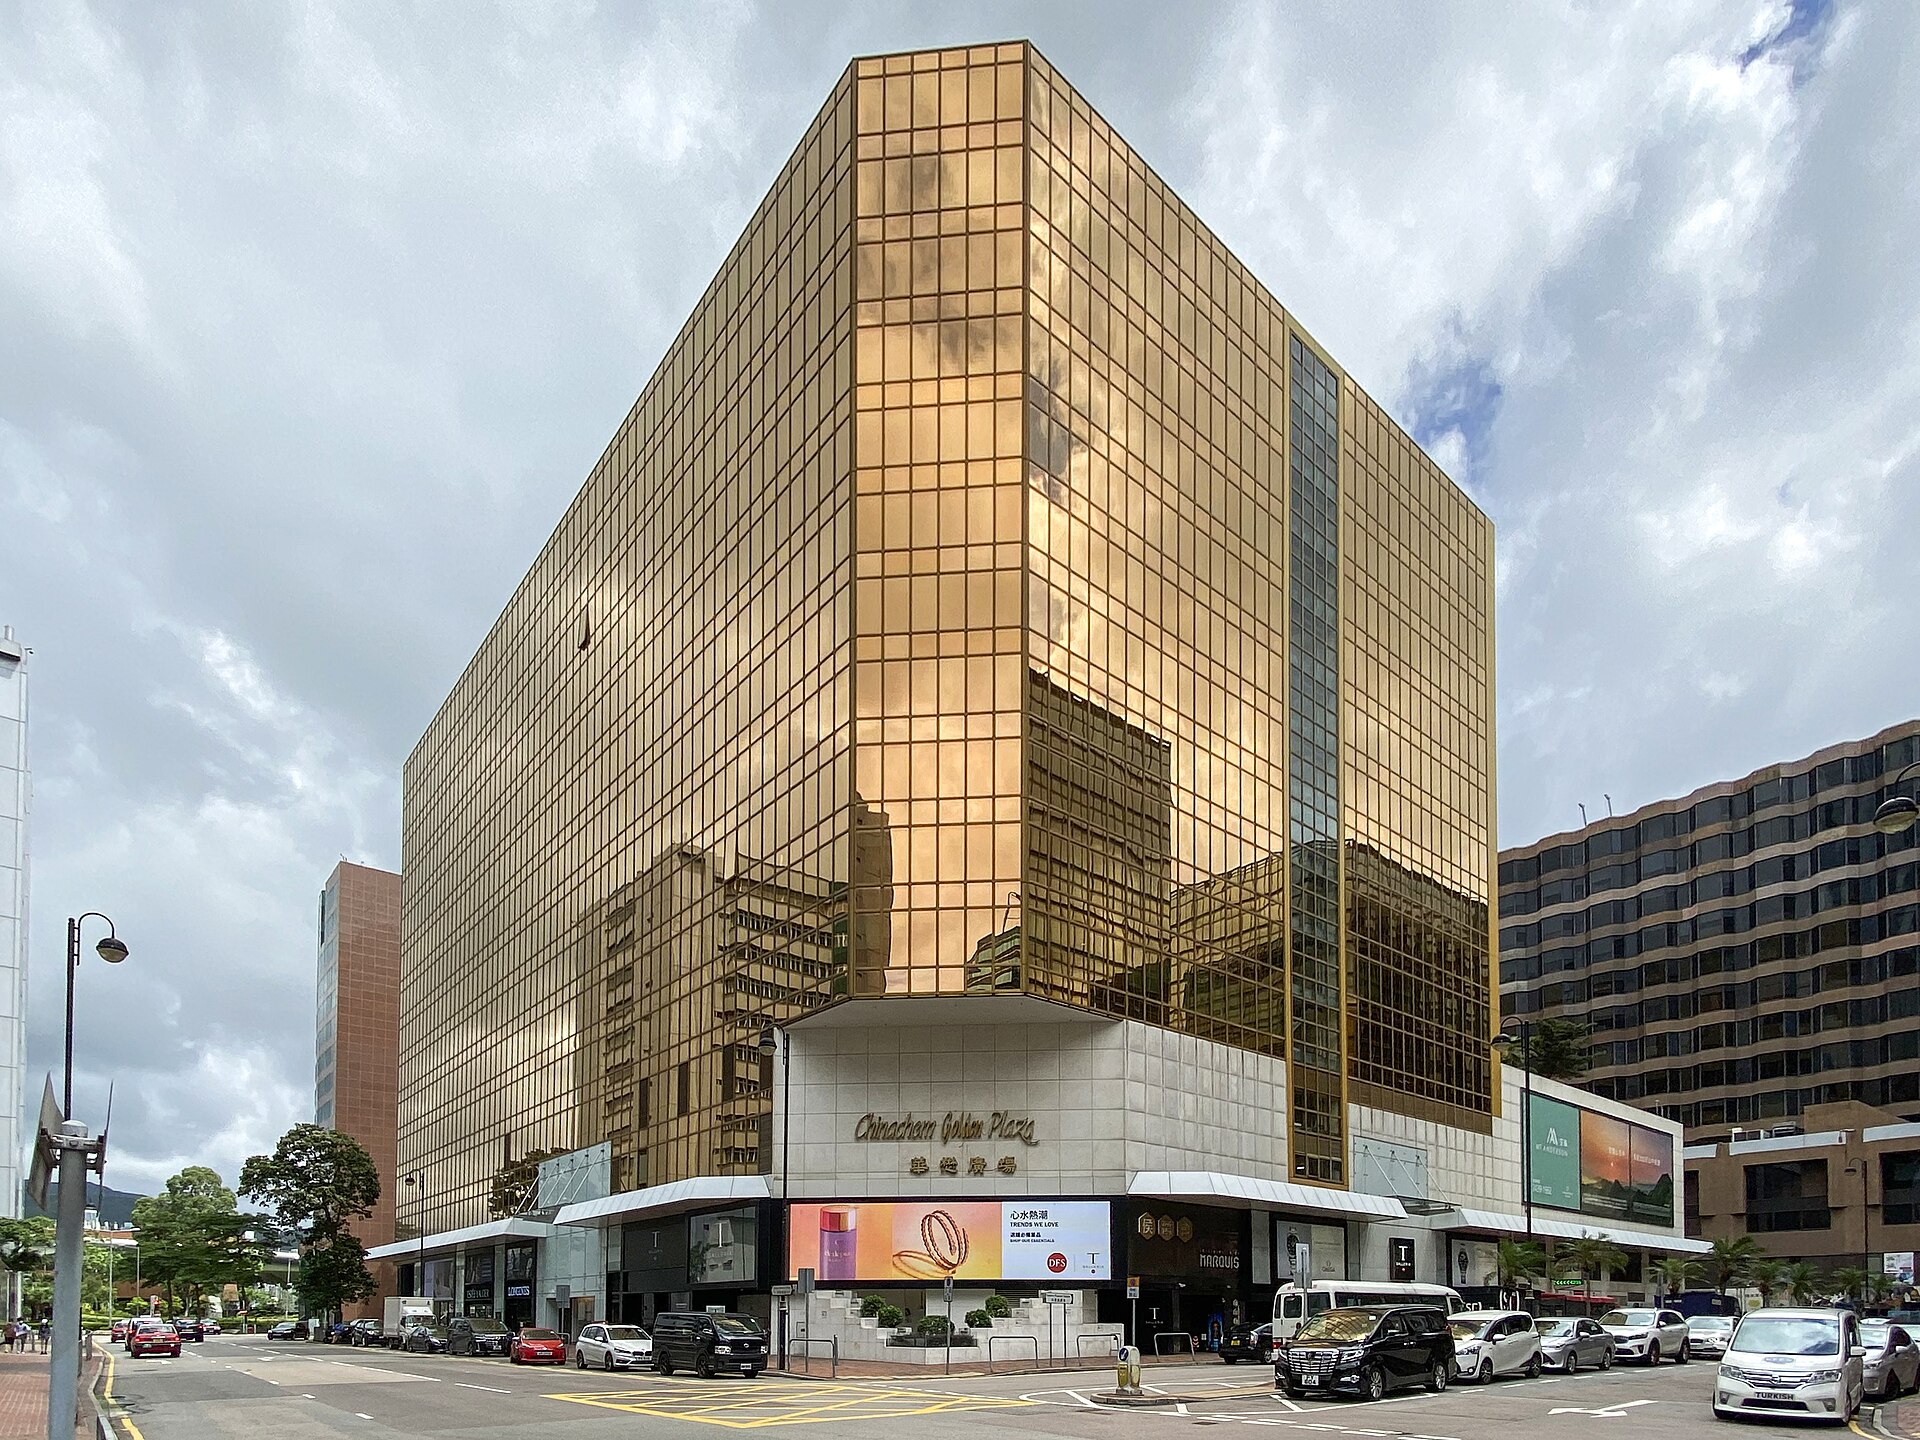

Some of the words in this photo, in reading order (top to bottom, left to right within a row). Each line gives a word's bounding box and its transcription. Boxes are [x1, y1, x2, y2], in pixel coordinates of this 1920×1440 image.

[854, 1112, 936, 1141] Chinachem
[941, 1110, 984, 1145] Golden
[988, 1110, 1040, 1146] Plaza
[910, 1156, 1017, 1176] 華懋廣場
[1009, 1210, 1048, 1220] 心水熱潮
[1086, 1252, 1100, 1265] T
[1398, 1245, 1409, 1261] T
[1048, 1258, 1066, 1268] DFS
[1199, 1253, 1240, 1269] MARQUIS
[507, 1286, 530, 1297] LONGINES
[1149, 1307, 1160, 1320] T
[1755, 1392, 1795, 1400] TURKISH
